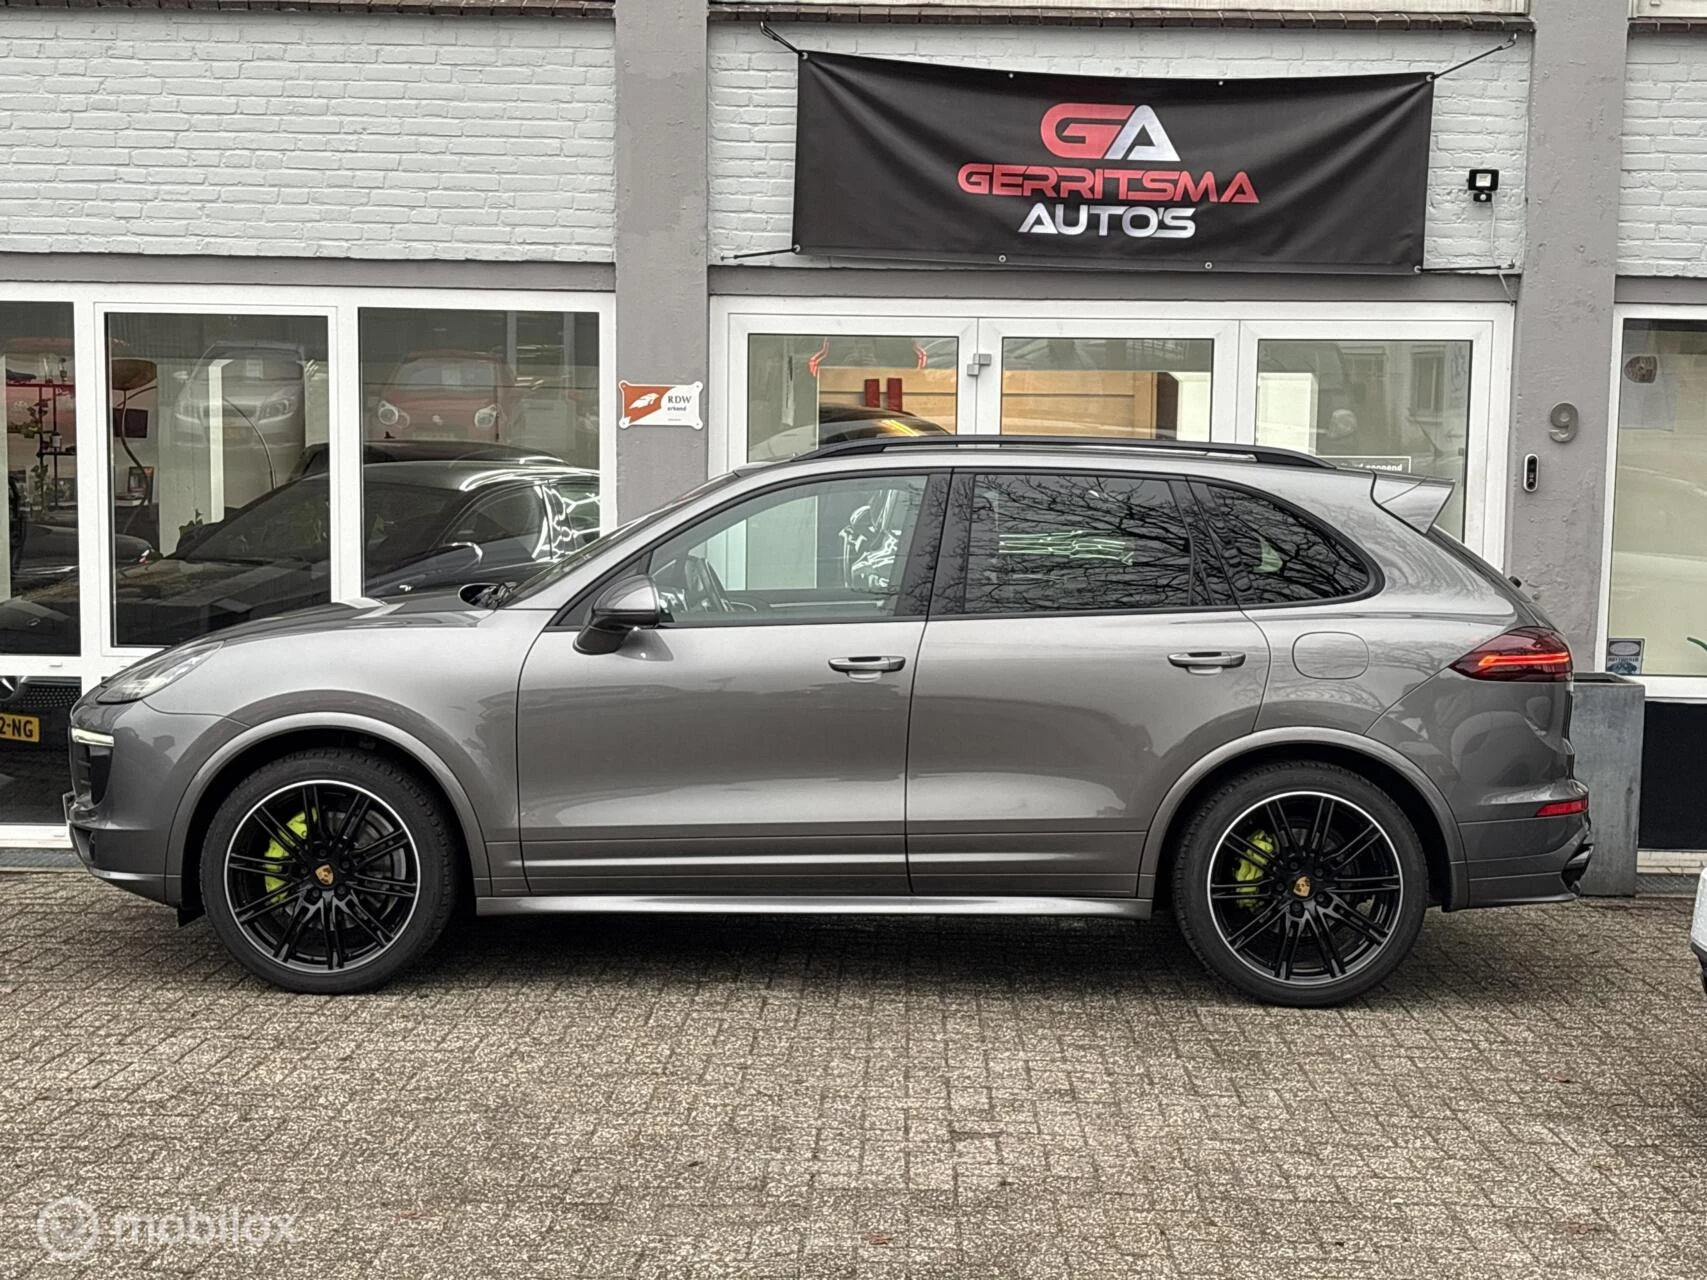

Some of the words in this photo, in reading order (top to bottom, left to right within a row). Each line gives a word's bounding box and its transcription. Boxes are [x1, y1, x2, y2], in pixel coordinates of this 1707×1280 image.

[1040, 103, 1181, 161] GA
[958, 163, 1260, 203] GERRITSMA
[1018, 203, 1196, 238] AUTO'S
[667, 395, 692, 404] RDW
[1550, 401, 1579, 443] 9
